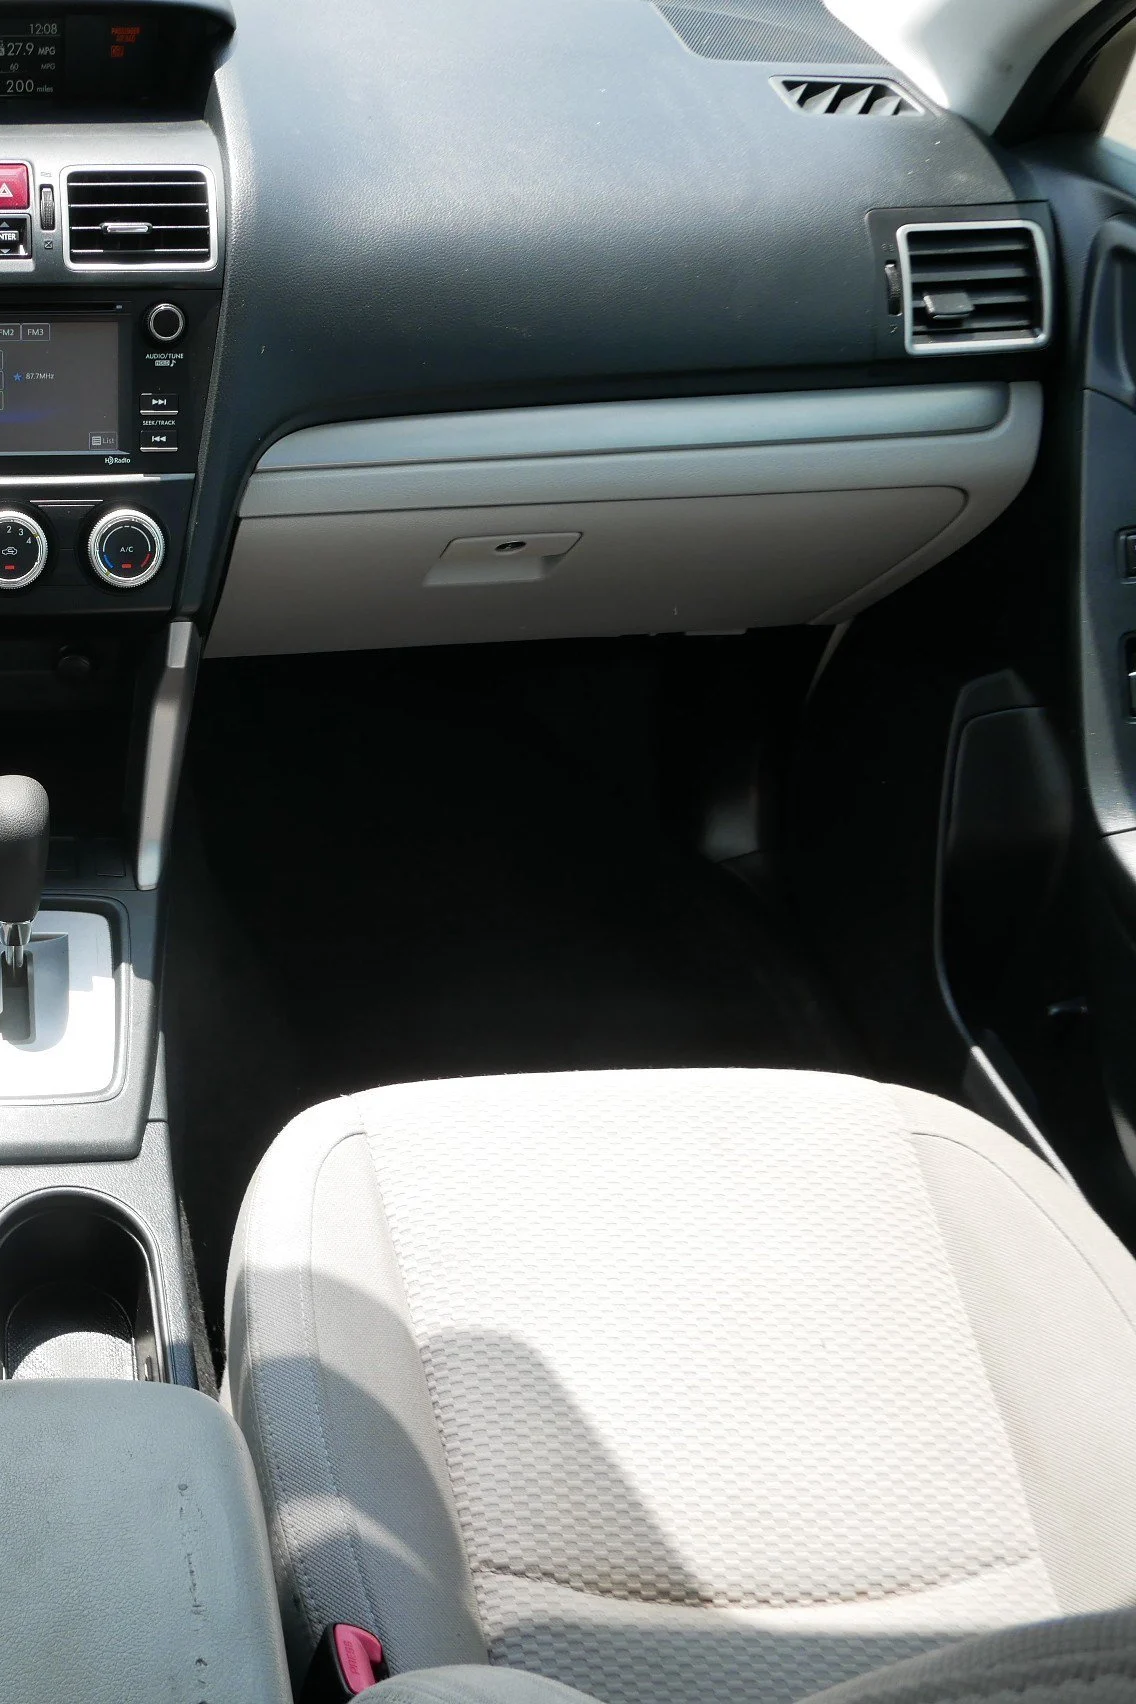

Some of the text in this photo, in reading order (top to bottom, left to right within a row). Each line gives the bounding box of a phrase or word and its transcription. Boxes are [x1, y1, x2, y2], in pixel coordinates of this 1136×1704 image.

[28, 23, 58, 35] 12:08
[6, 42, 56, 56] 27.9 MPG
[9, 63, 19, 71] 60
[40, 62, 56, 71] MPG
[6, 80, 54, 93] 200 miles
[27, 328, 44, 336] FM3
[114, 456, 131, 464] Radio
[6, 525, 12, 533] 2
[18, 528, 24, 536] 3
[119, 545, 134, 553] A/C
[343, 1640, 360, 1675] PRESS
